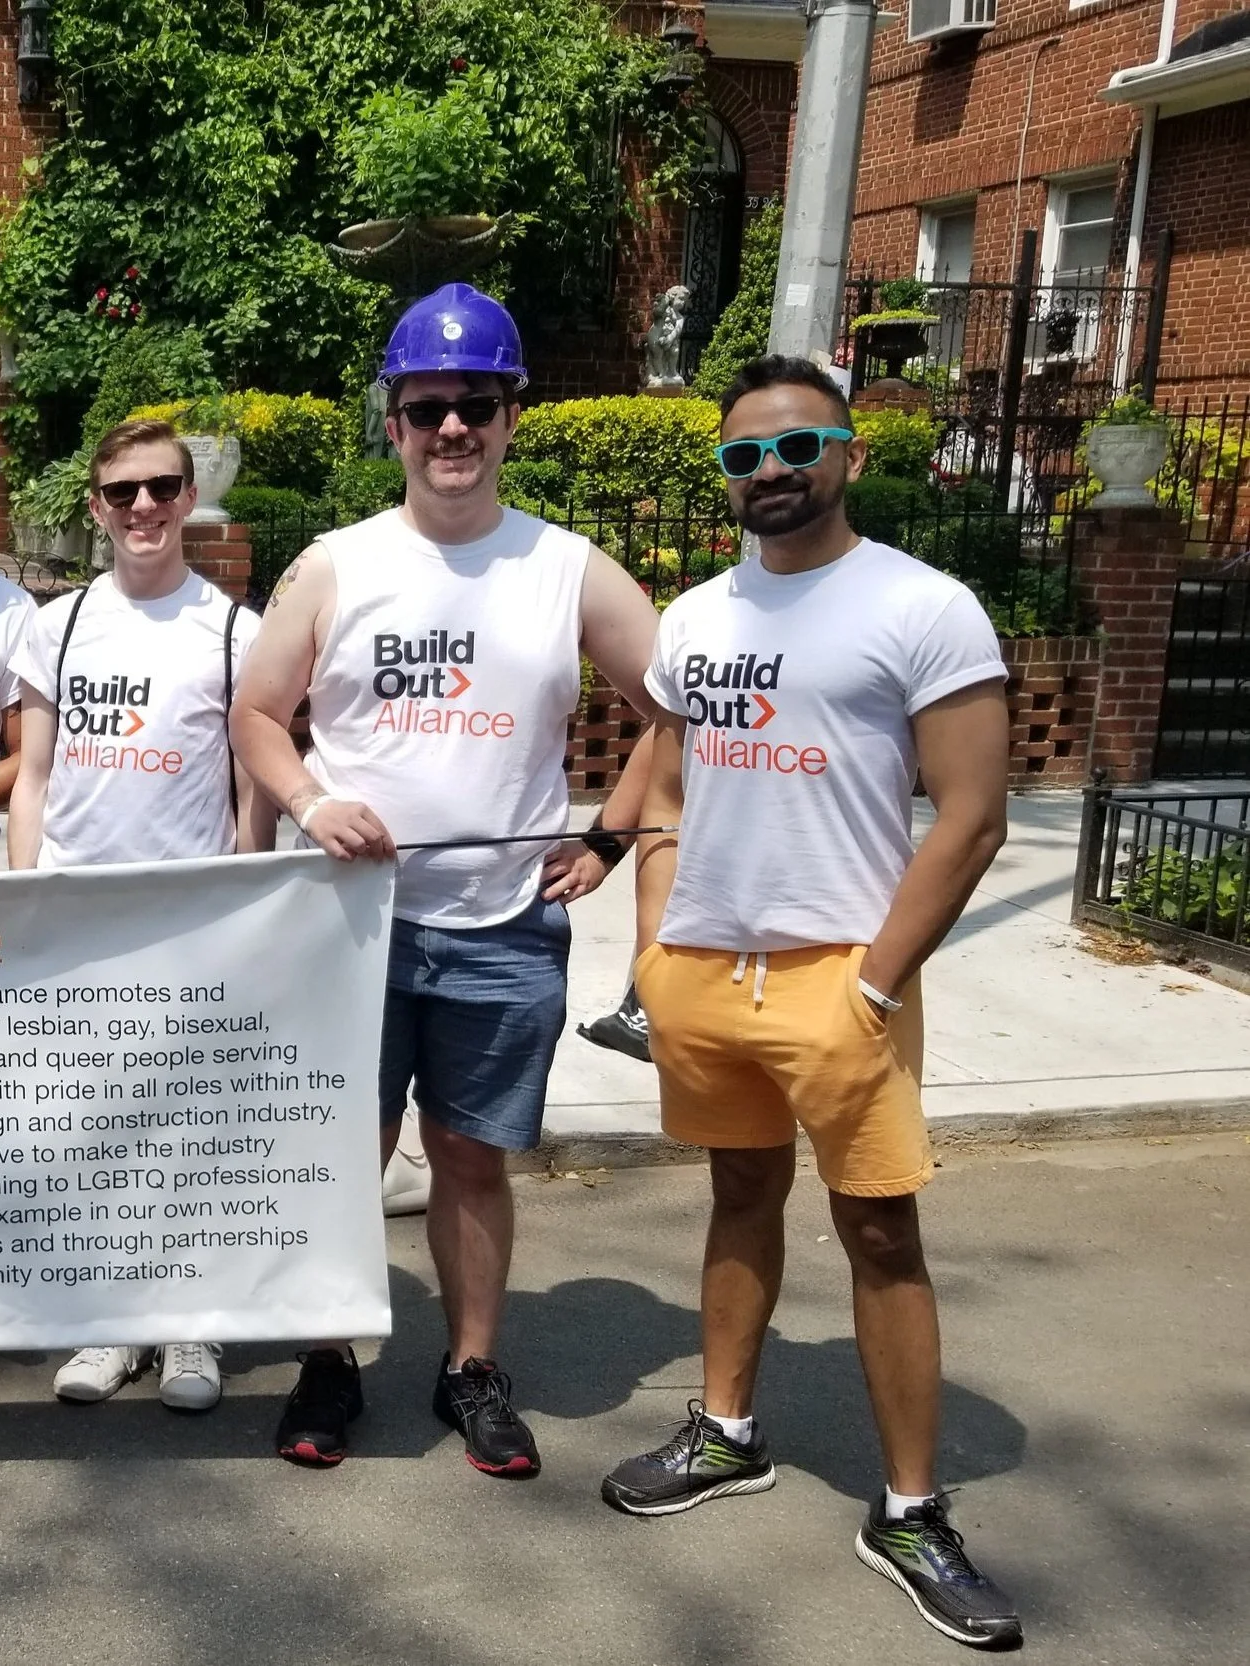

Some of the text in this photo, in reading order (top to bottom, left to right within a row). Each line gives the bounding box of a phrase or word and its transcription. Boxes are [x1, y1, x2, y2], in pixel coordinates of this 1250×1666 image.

[374, 629, 475, 668] Build
[372, 667, 446, 700] Out
[683, 653, 784, 690] Build
[69, 675, 151, 707] Build
[65, 705, 123, 736] Out
[372, 700, 515, 738] Alliance
[686, 690, 750, 729] Out
[65, 736, 183, 774] Alliance
[694, 728, 827, 775] Alliance
[56, 983, 172, 1009] promotes
[179, 981, 225, 1003] and
[7, 1014, 98, 1039] lesbian,
[107, 1019, 155, 1041] gay,
[165, 1011, 270, 1035] bisexual,
[46, 1051, 115, 1073] queer
[123, 1045, 205, 1072] people
[212, 1041, 298, 1065] serving
[35, 1079, 96, 1105] pride
[104, 1079, 123, 1100] in
[131, 1077, 157, 1099] all
[166, 1075, 223, 1097] roles
[229, 1071, 299, 1093] within
[306, 1069, 346, 1090] the
[28, 1111, 72, 1132] and
[80, 1105, 229, 1131] construction
[237, 1102, 336, 1126] industry.
[31, 1144, 56, 1163] to
[63, 1140, 128, 1162] make
[134, 1138, 173, 1158] the
[181, 1134, 276, 1158] industry
[45, 1174, 69, 1193] to
[77, 1169, 165, 1191] LGBTQ
[173, 1162, 336, 1193] professionals.
[90, 1201, 109, 1221] in
[117, 1204, 157, 1220] our
[163, 1201, 212, 1219] own
[220, 1195, 279, 1216] work
[11, 1232, 55, 1254] and
[62, 1230, 153, 1255] through
[162, 1226, 308, 1254] partnerships
[40, 1260, 203, 1287] organizations.
